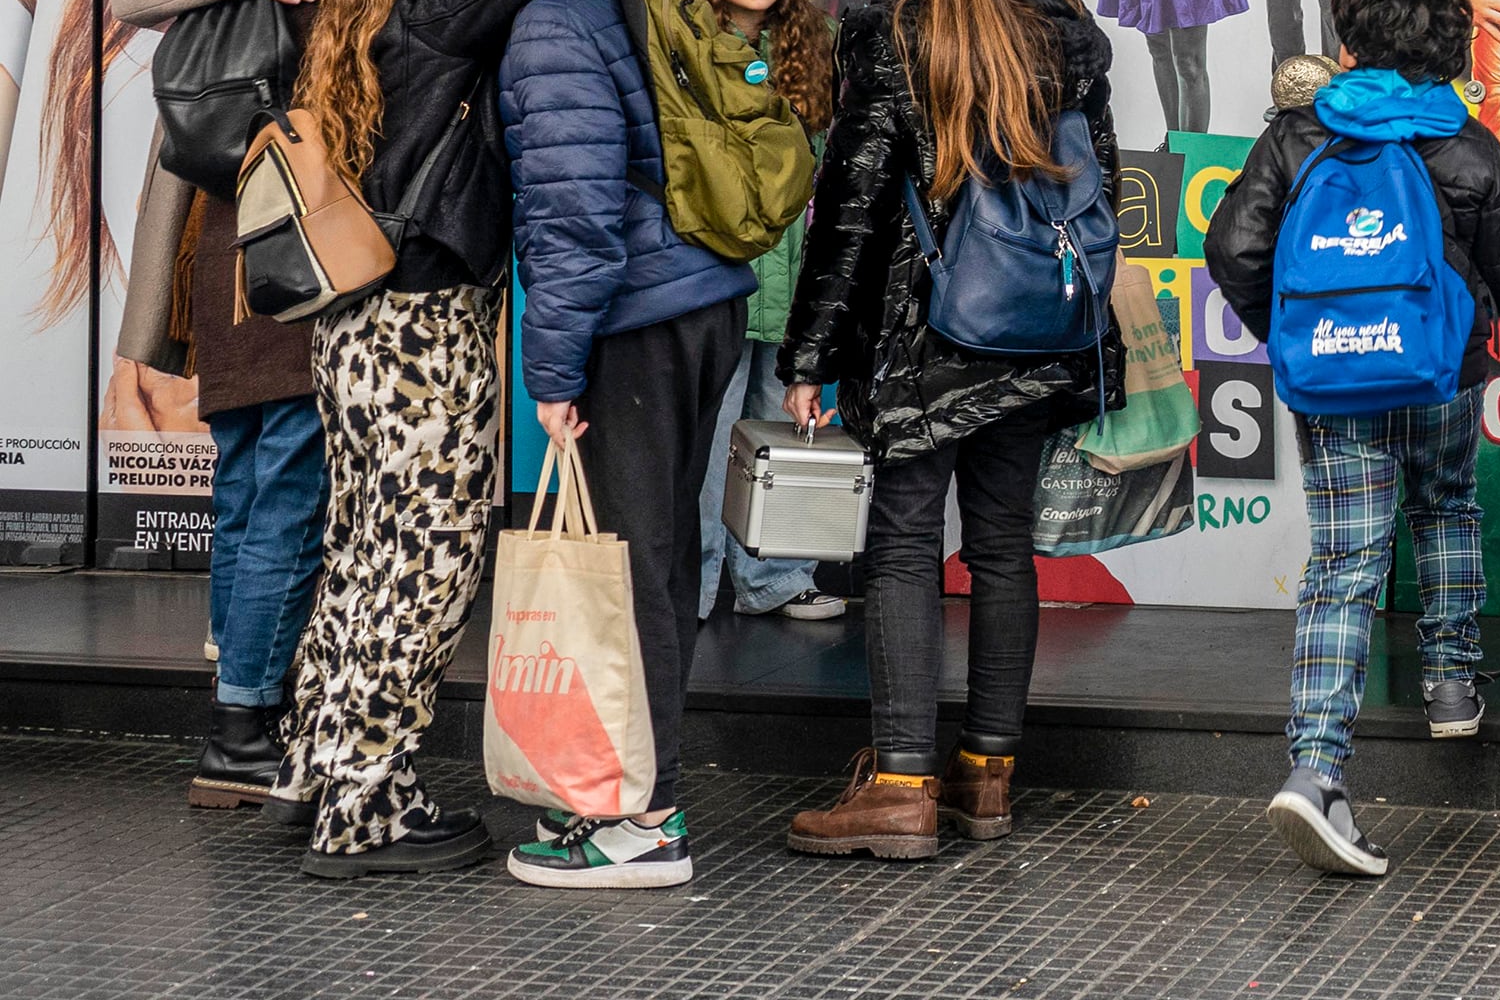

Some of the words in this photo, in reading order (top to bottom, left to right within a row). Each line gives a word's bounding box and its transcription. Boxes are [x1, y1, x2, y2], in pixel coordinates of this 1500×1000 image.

[1311, 223, 1407, 251] RECREAR
[1334, 325, 1357, 342] you
[1359, 316, 1388, 338] need
[1312, 335, 1403, 357] RECREAR
[5, 438, 80, 450] PRODUCCIÓN
[109, 441, 183, 454] PRODUCCIÓN
[186, 444, 216, 455] GENE
[0, 452, 25, 465] RIA
[109, 454, 176, 470] NICOLÁS
[109, 473, 186, 487] PRELUDIO
[134, 531, 159, 550] EN
[164, 531, 214, 552] VENT
